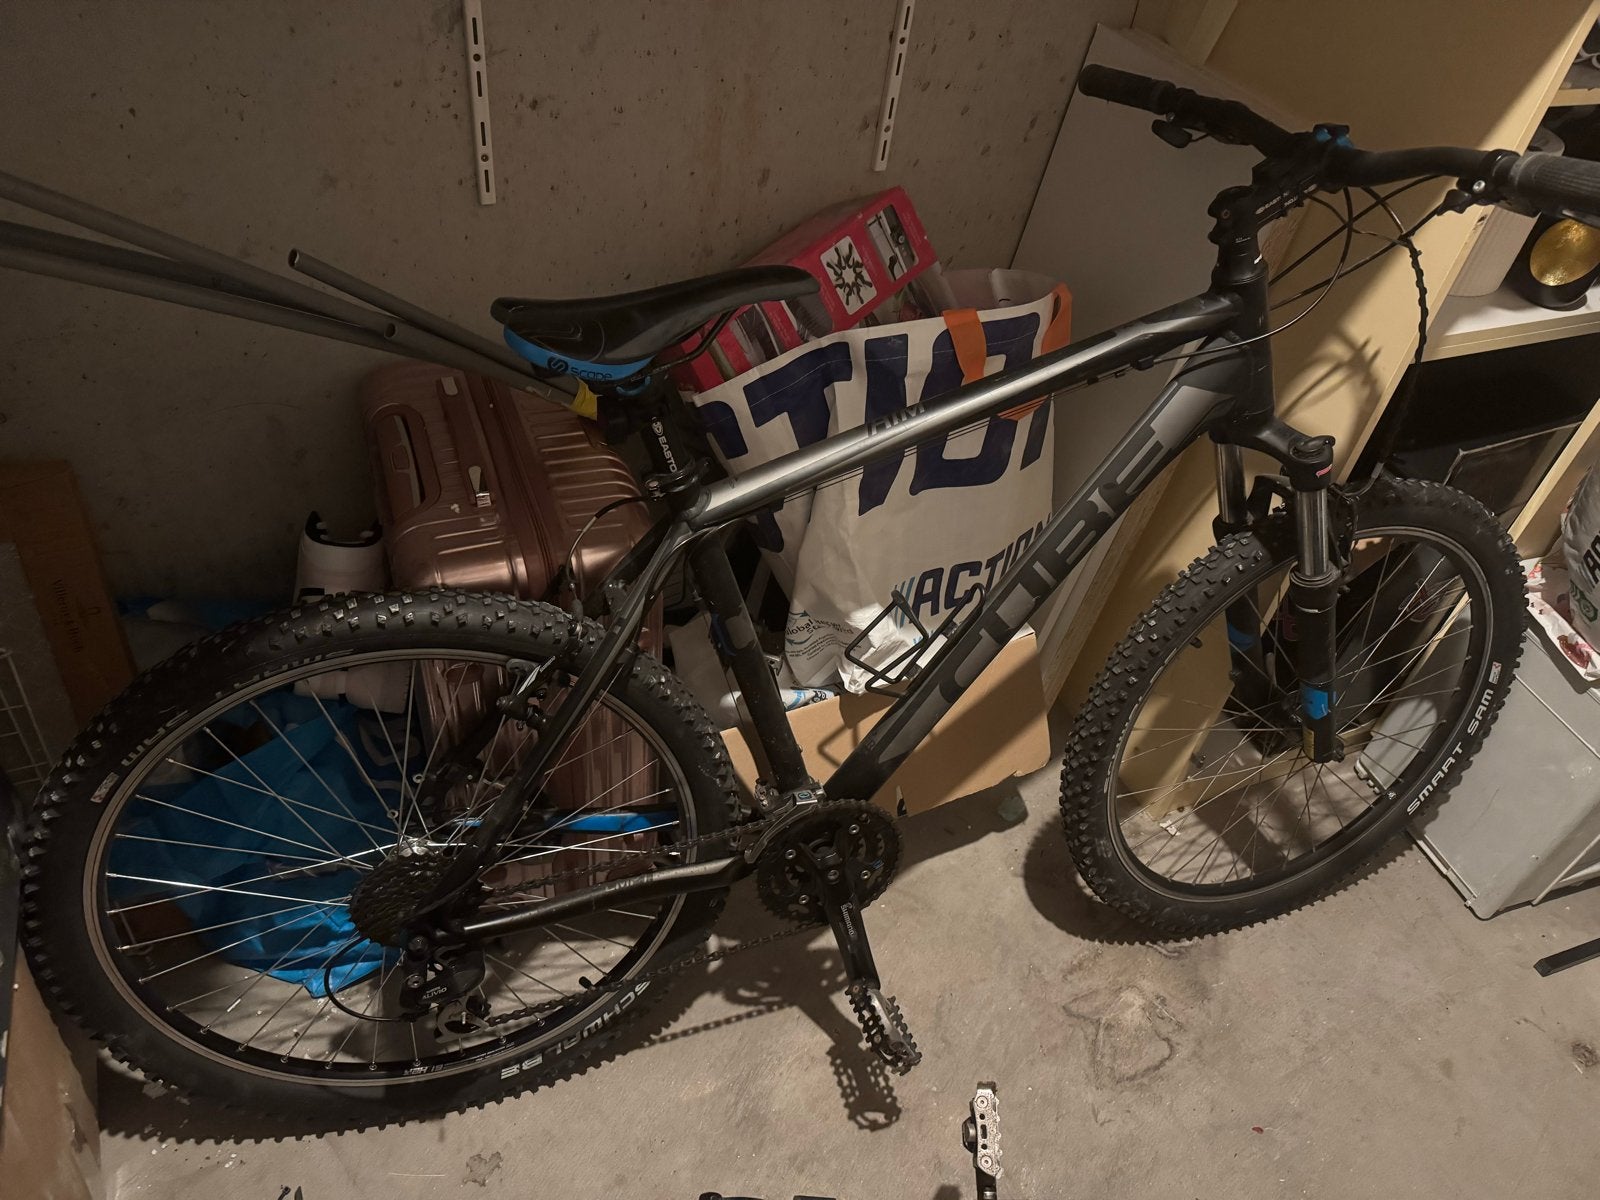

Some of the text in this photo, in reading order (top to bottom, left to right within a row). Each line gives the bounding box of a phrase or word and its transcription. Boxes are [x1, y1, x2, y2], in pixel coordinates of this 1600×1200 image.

[658, 436, 679, 474] EASTO
[909, 511, 1052, 624] ACTIO
[937, 424, 1170, 704] CUBE
[785, 619, 814, 636] lobal
[1406, 688, 1494, 816] SMART SAM
[422, 985, 448, 1000] ALIVIO
[499, 980, 652, 1081] SCHWALBE
